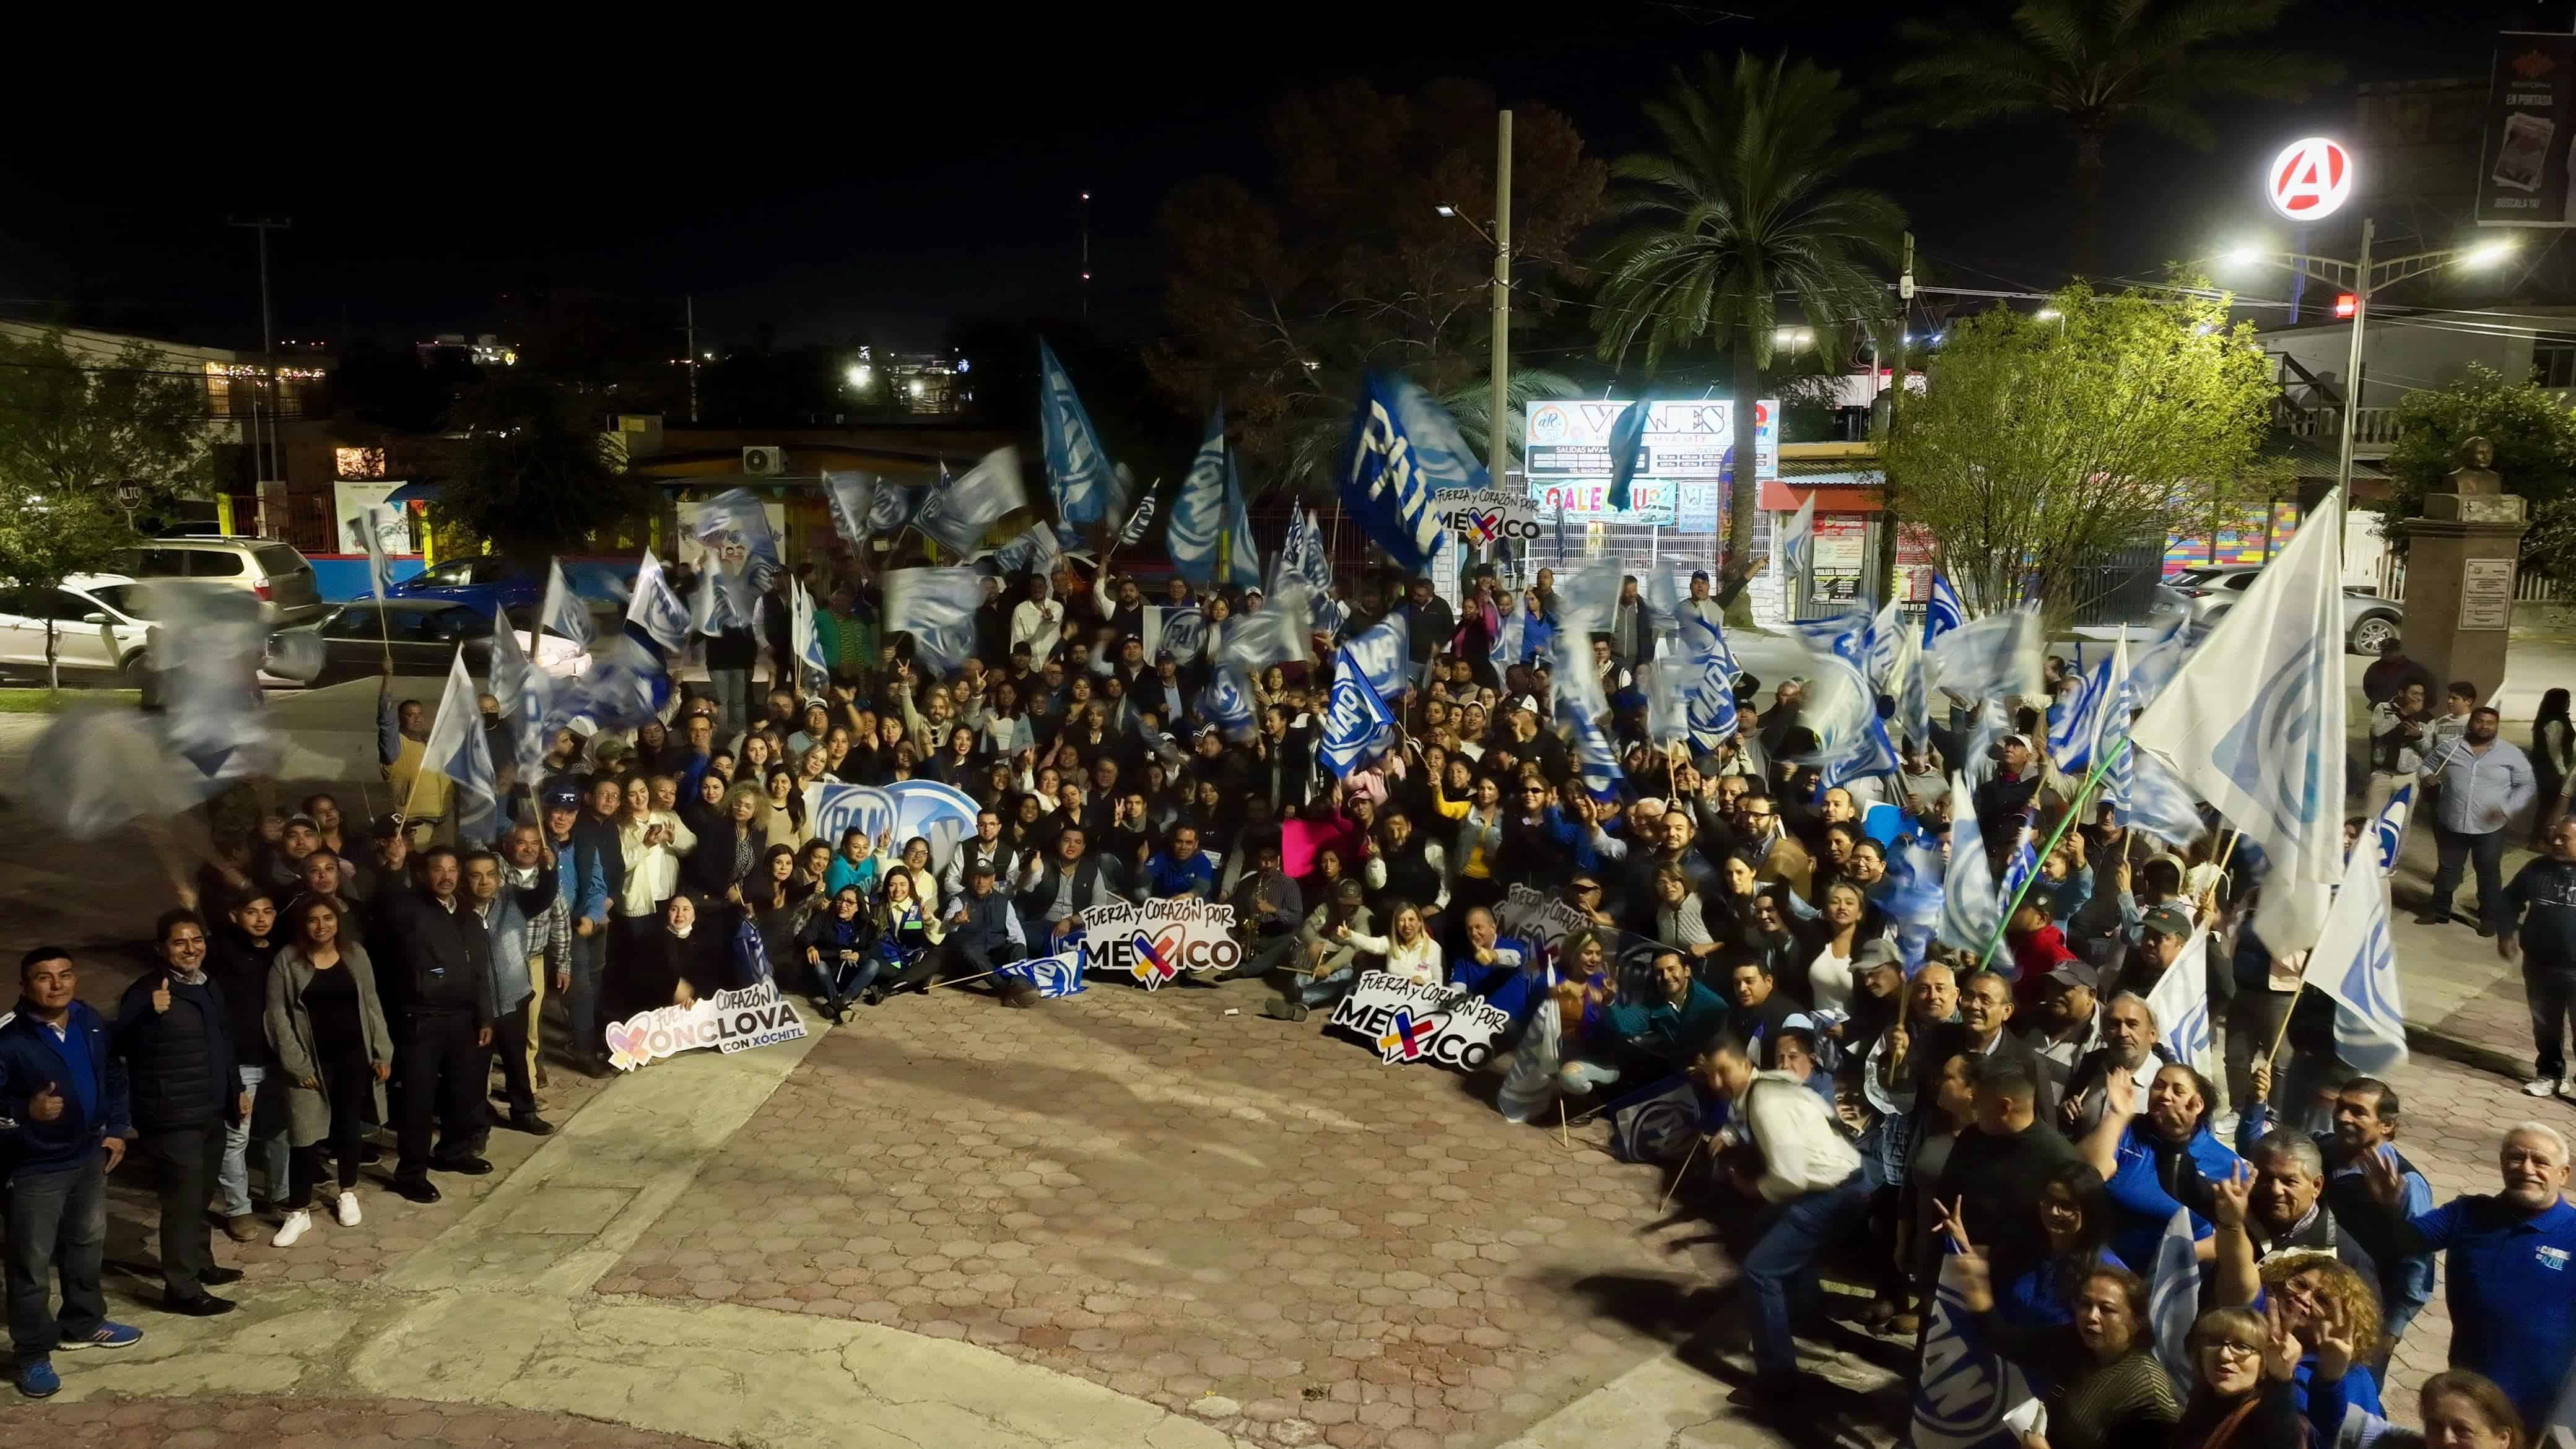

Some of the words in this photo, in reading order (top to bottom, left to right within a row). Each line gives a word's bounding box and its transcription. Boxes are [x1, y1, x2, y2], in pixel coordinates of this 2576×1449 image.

[1437, 489, 1471, 503] FUERZA
[1479, 488, 1518, 507] CORAZÓN
[1520, 497, 1540, 512] POR
[830, 806, 886, 846] PAN
[1085, 905, 1133, 929] FUERZA
[1134, 908, 1143, 925] y
[1145, 900, 1201, 921] CORAZÓN
[1205, 906, 1233, 928] POR
[1081, 933, 1238, 980] MÉXICO
[716, 983, 772, 1011] CORAZÓN
[1360, 972, 1409, 996] FUERZA
[1473, 1007, 1507, 1031] POR
[723, 1038, 750, 1052] CON
[752, 1028, 804, 1046] XÓCHITL
[1335, 998, 1490, 1070] MÉXICO
